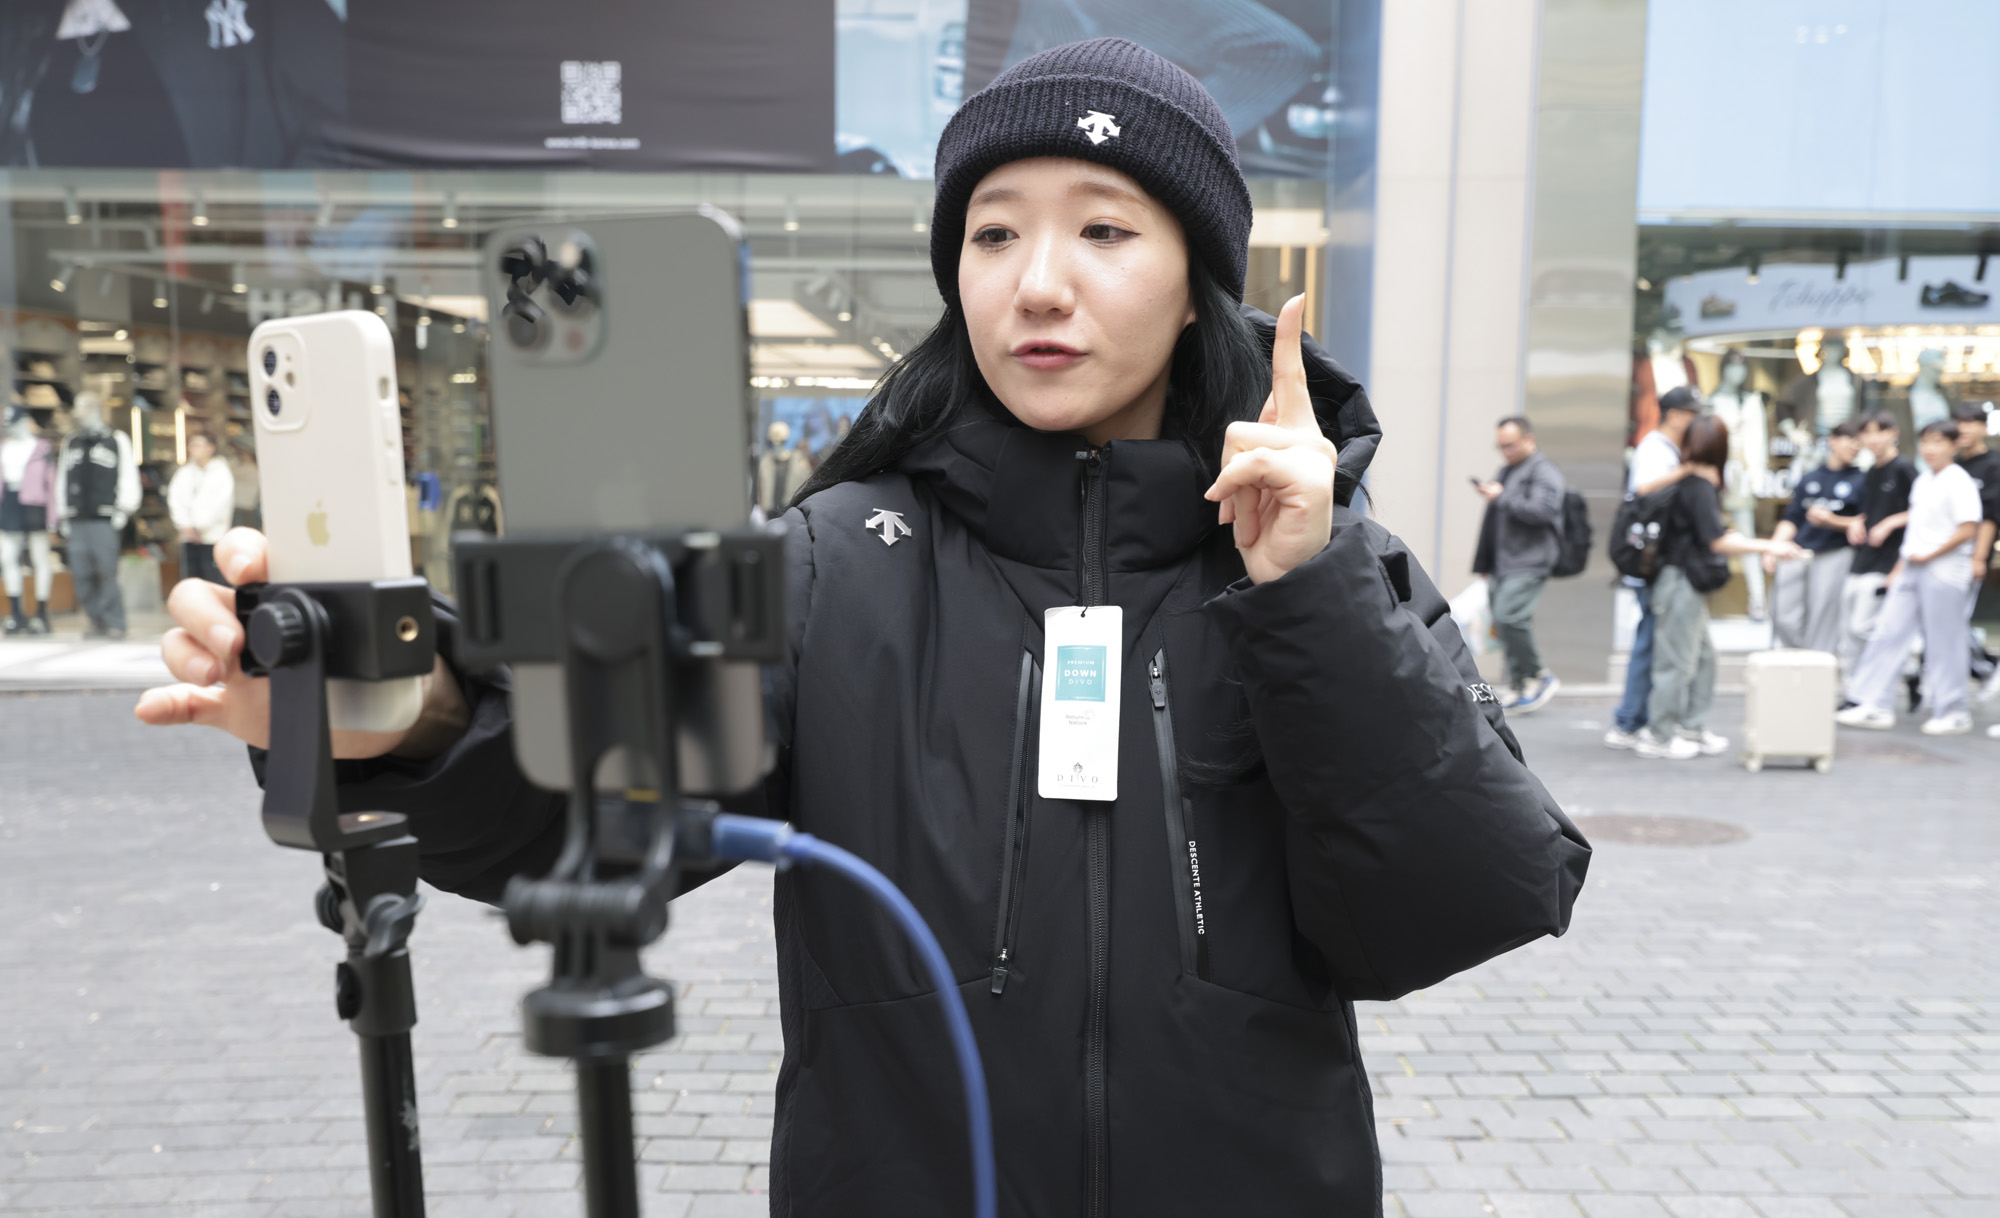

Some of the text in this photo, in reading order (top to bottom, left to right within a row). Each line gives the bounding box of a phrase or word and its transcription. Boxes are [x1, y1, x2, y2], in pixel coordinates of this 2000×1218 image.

[1064, 669, 1097, 677] DOWN
[1057, 774, 1099, 784] DIVO
[1188, 840, 1205, 935] DESCENTE ATHLETIC
